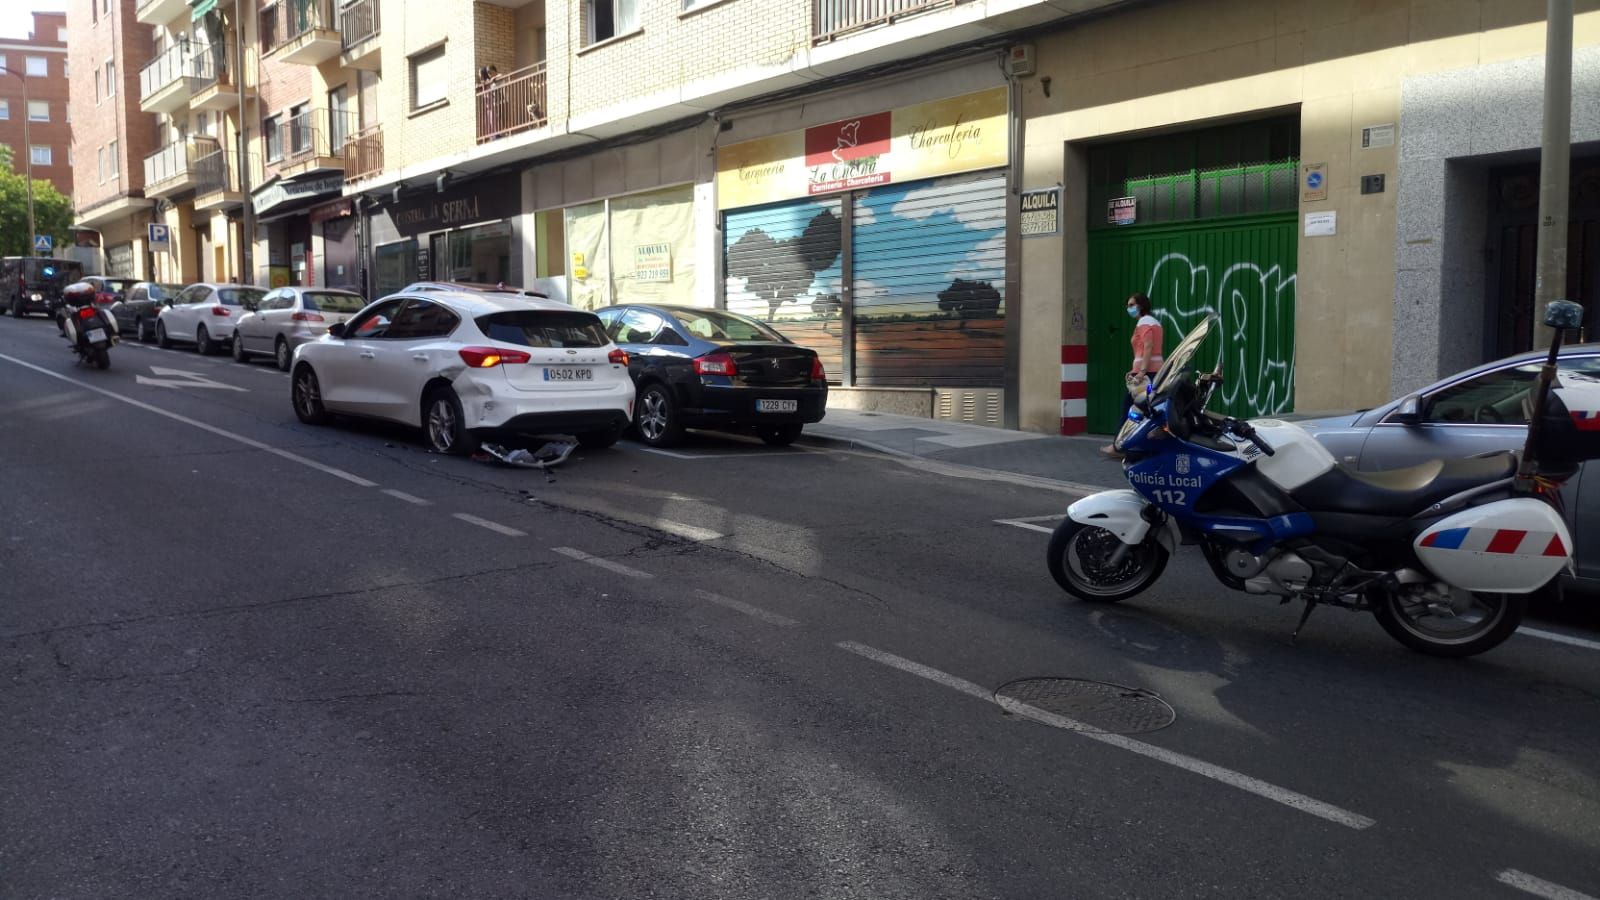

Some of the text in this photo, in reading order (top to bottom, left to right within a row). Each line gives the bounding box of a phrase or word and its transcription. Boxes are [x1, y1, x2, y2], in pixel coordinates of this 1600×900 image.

[809, 166, 827, 184] La
[1021, 193, 1056, 210] ALQUILA
[153, 226, 165, 241] P
[638, 245, 667, 256] ALQUILA
[550, 369, 592, 380] 0502 KPD
[762, 400, 780, 410] 1229
[1128, 470, 1202, 489] Policía Local
[1152, 489, 1186, 506] 112
